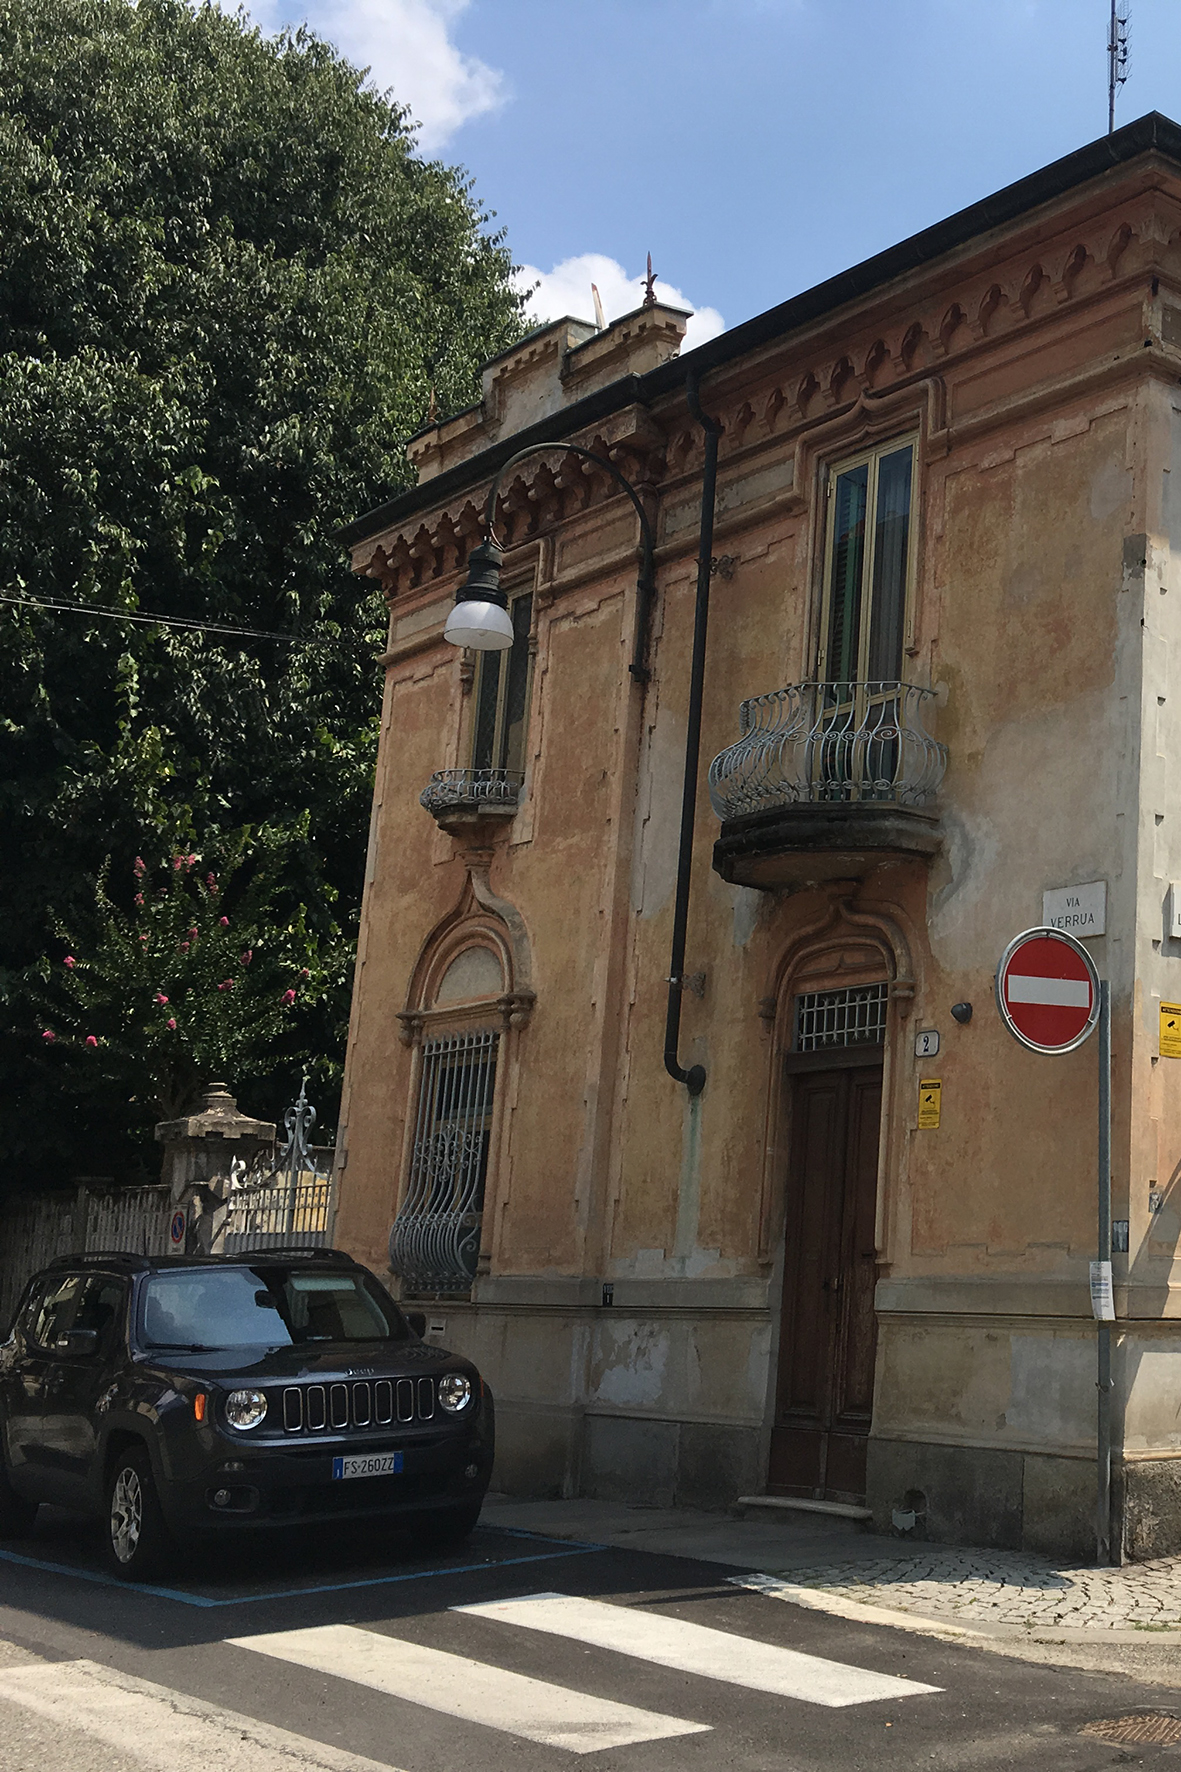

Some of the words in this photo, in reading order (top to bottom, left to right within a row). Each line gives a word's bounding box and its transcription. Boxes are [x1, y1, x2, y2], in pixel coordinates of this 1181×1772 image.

[1066, 897, 1081, 907] VIA
[1050, 912, 1095, 929] VERRUA
[923, 1035, 930, 1053] 2
